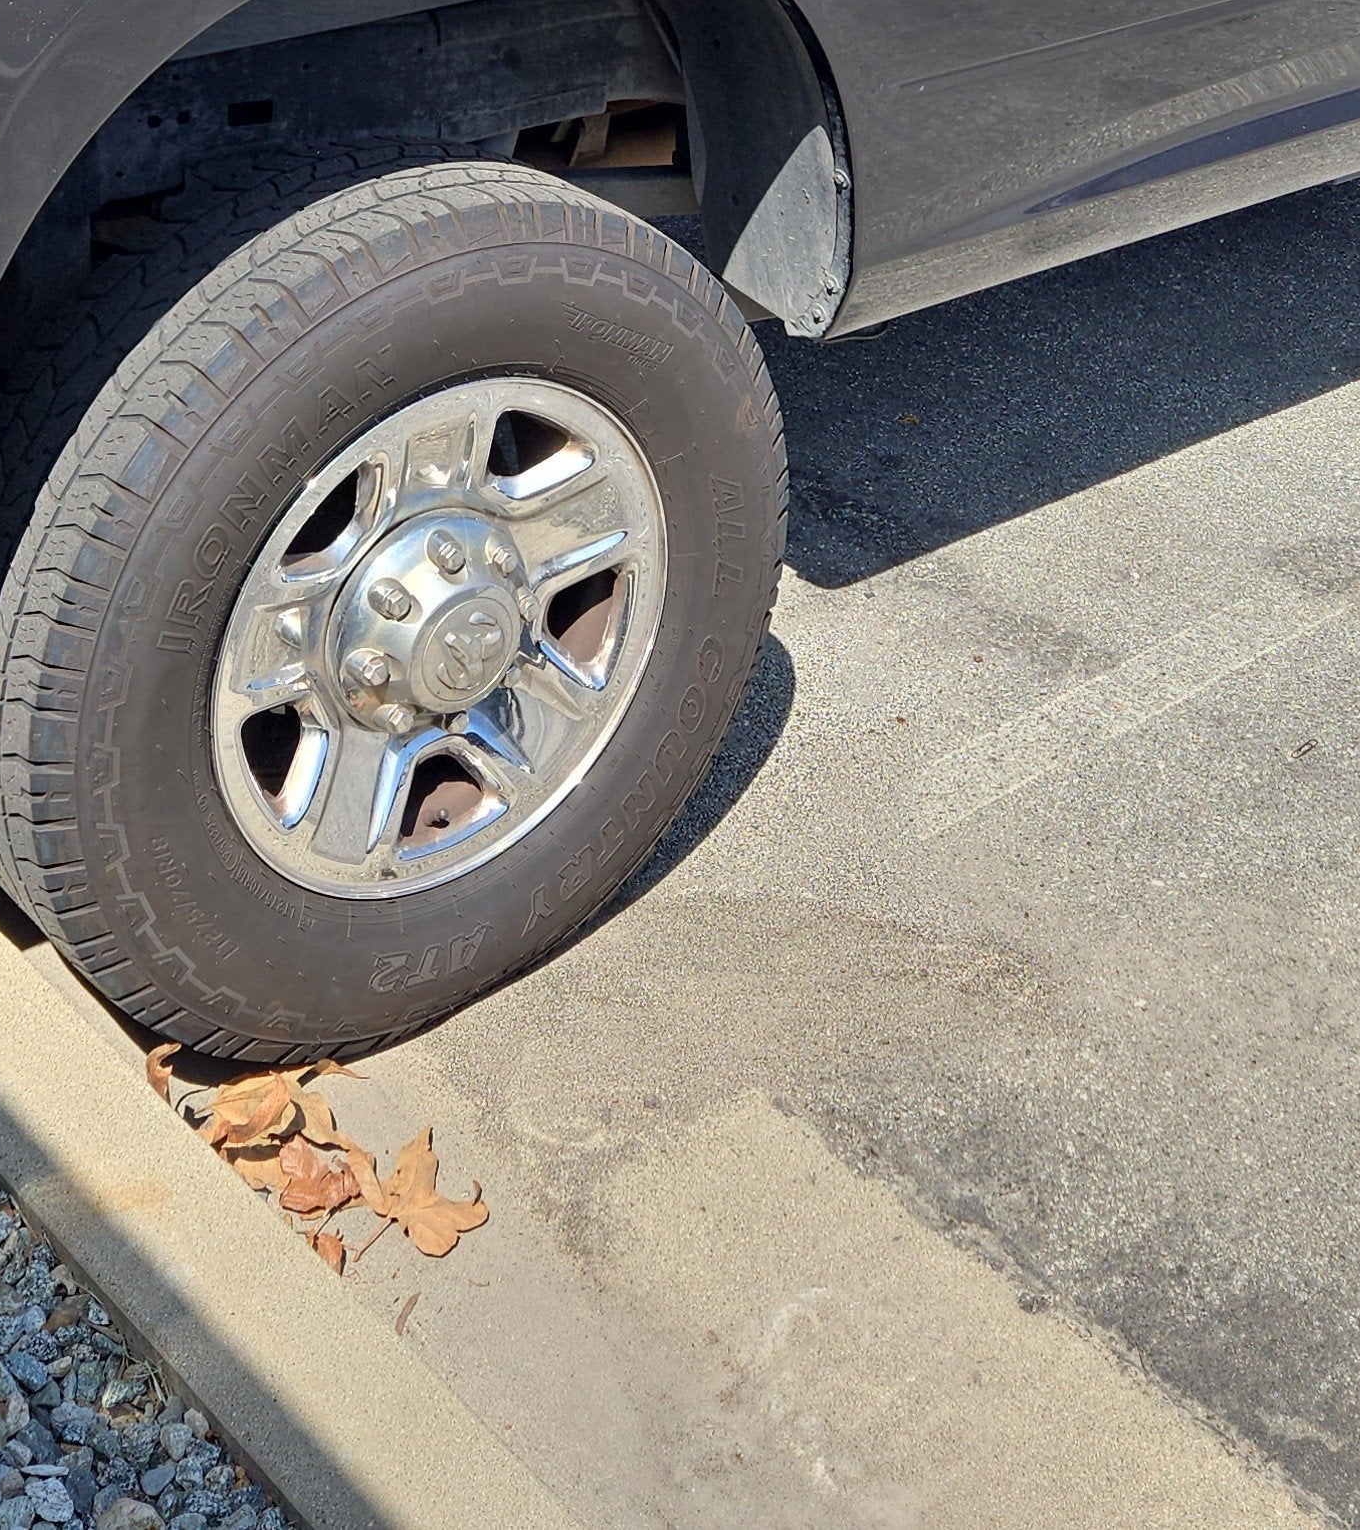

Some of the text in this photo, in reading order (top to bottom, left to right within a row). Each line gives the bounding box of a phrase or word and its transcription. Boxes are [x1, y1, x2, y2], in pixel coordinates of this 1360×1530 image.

[568, 310, 675, 363] IRONMAN
[156, 342, 398, 653] IRONMAN
[367, 473, 746, 995] ALL COUNTRY AT2
